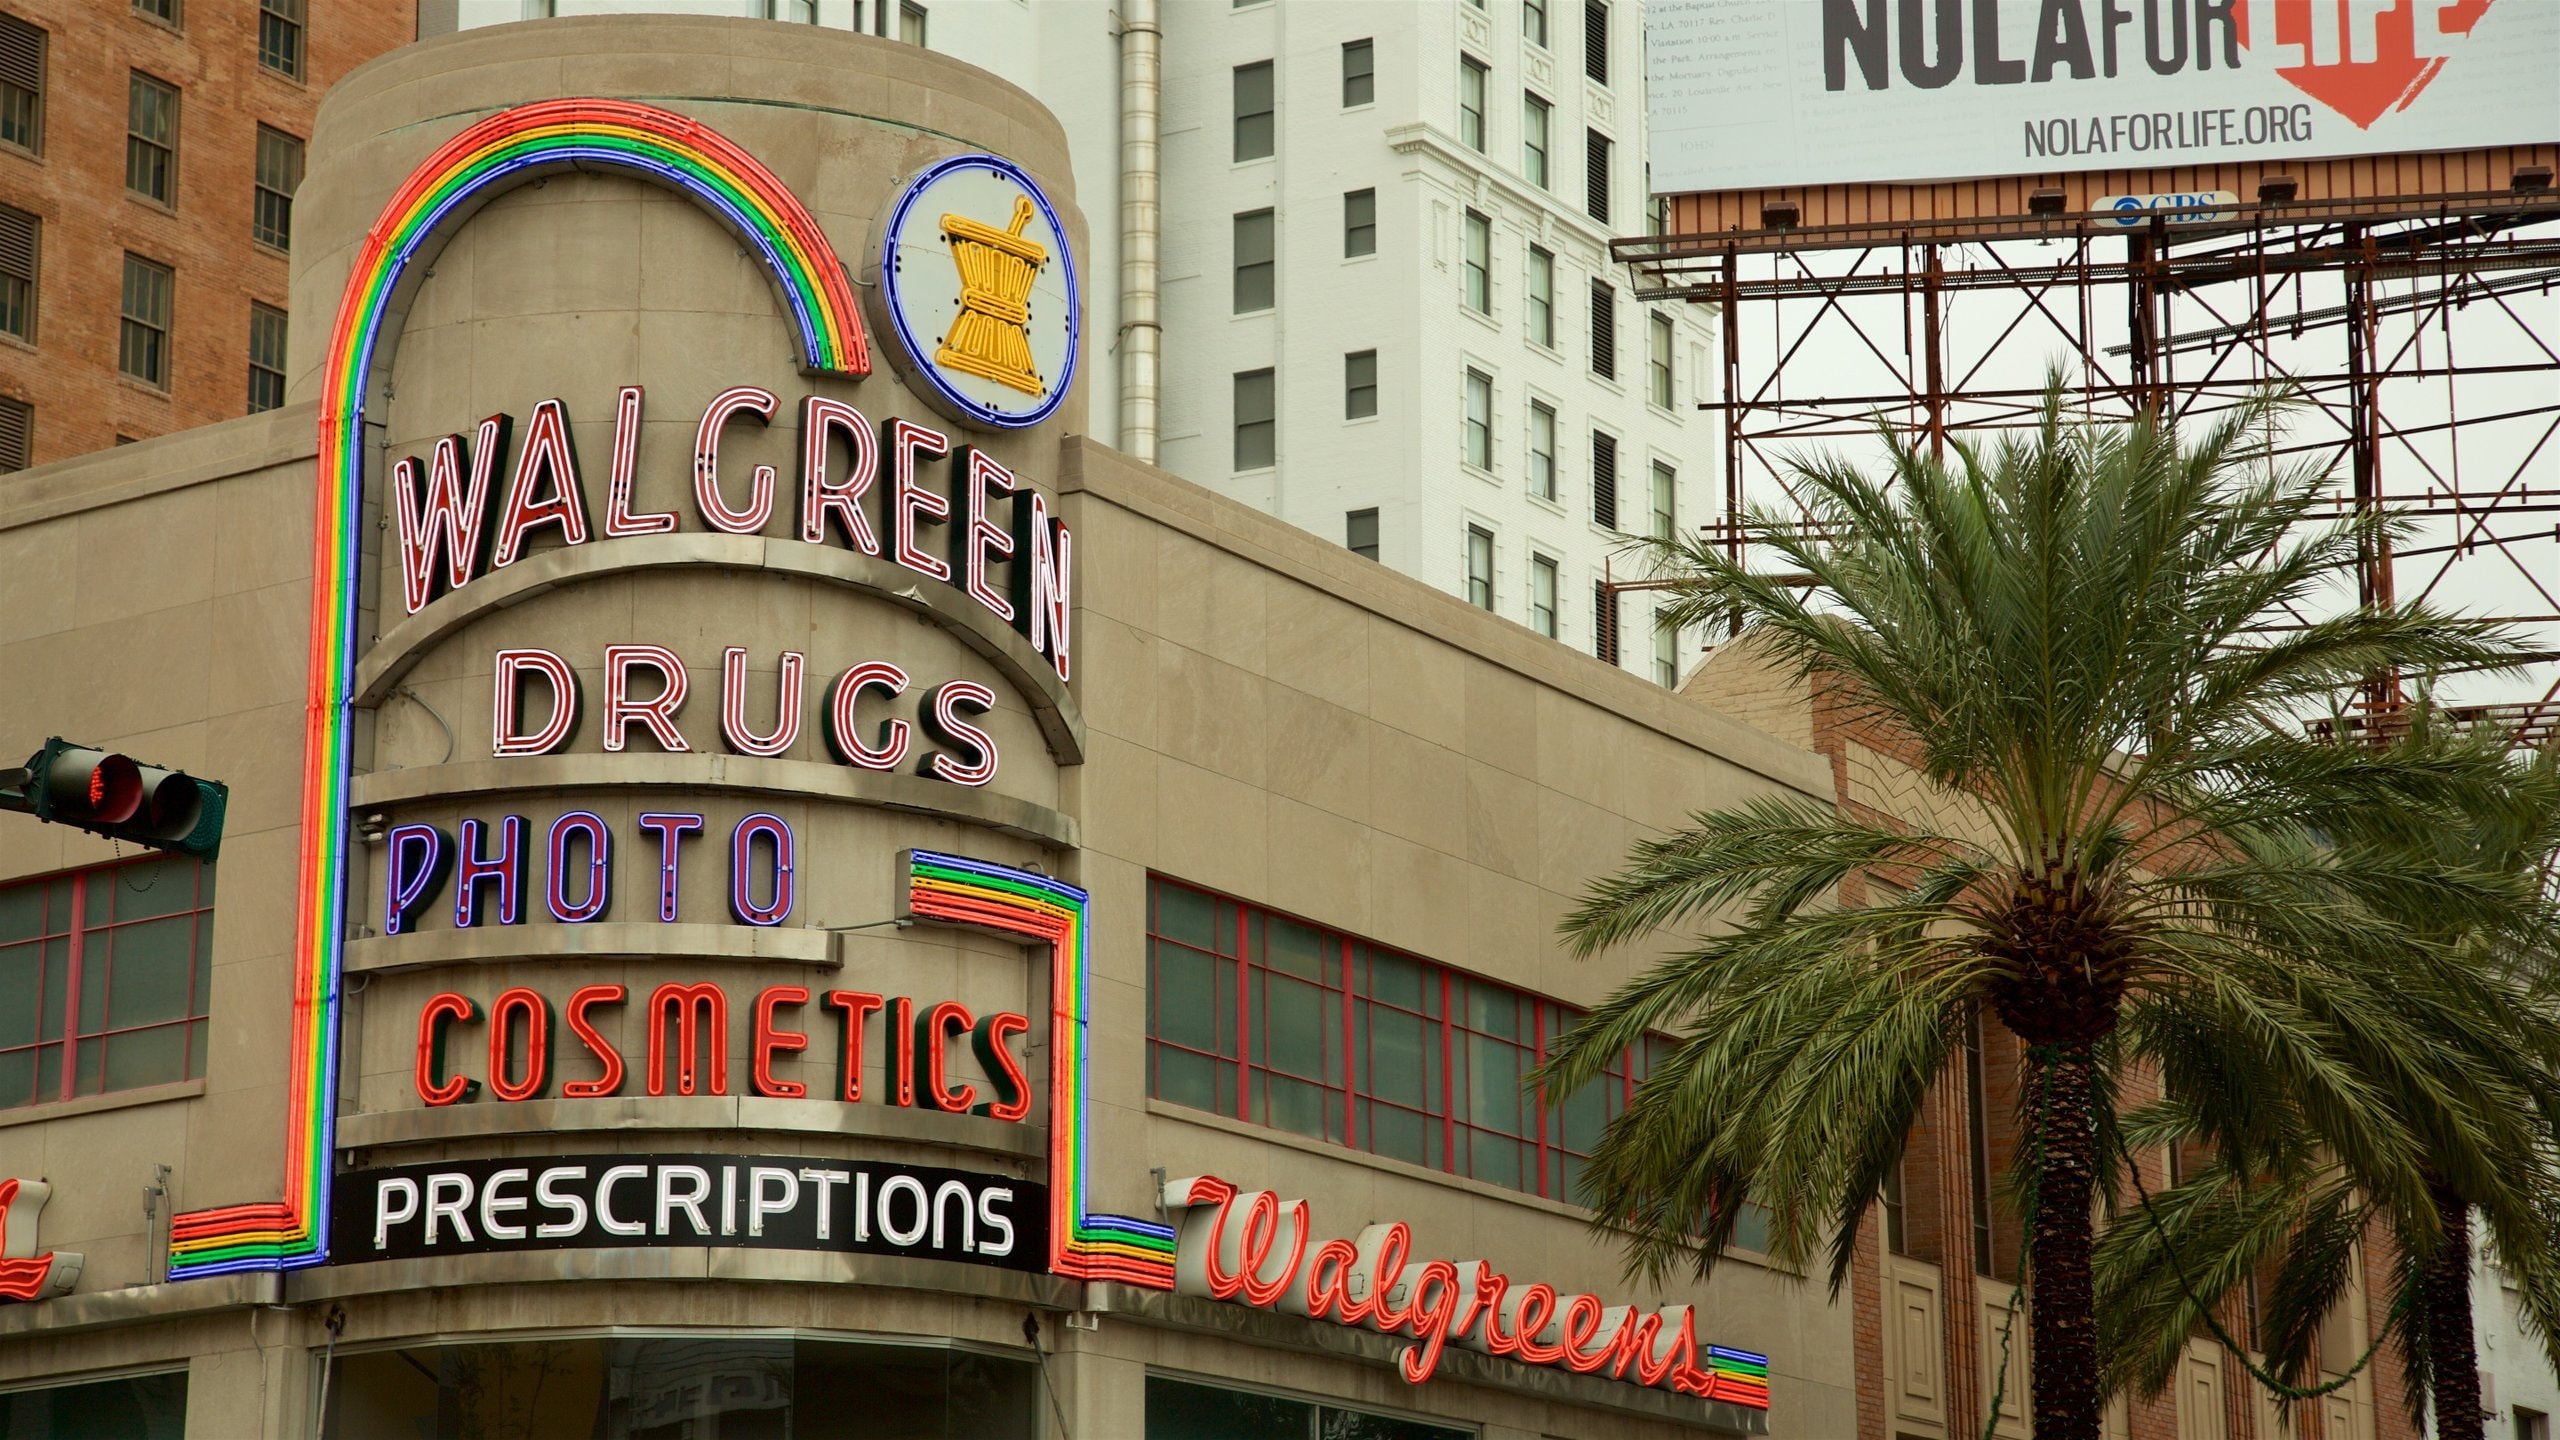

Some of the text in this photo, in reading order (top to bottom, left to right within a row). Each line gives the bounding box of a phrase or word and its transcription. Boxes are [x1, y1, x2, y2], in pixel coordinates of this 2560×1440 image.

[2025, 103, 2312, 157] NOLAFORLIFE.ORG
[2150, 193, 2217, 222] CBS
[394, 385, 1071, 683] WALGREEN
[492, 644, 999, 788] DRUGS
[385, 810, 796, 936] PHOTO
[415, 982, 1032, 1121] COSMETICS
[373, 1163, 1016, 1257] PRESCRIPTIONS
[1180, 1174, 1717, 1385] Walgreens
